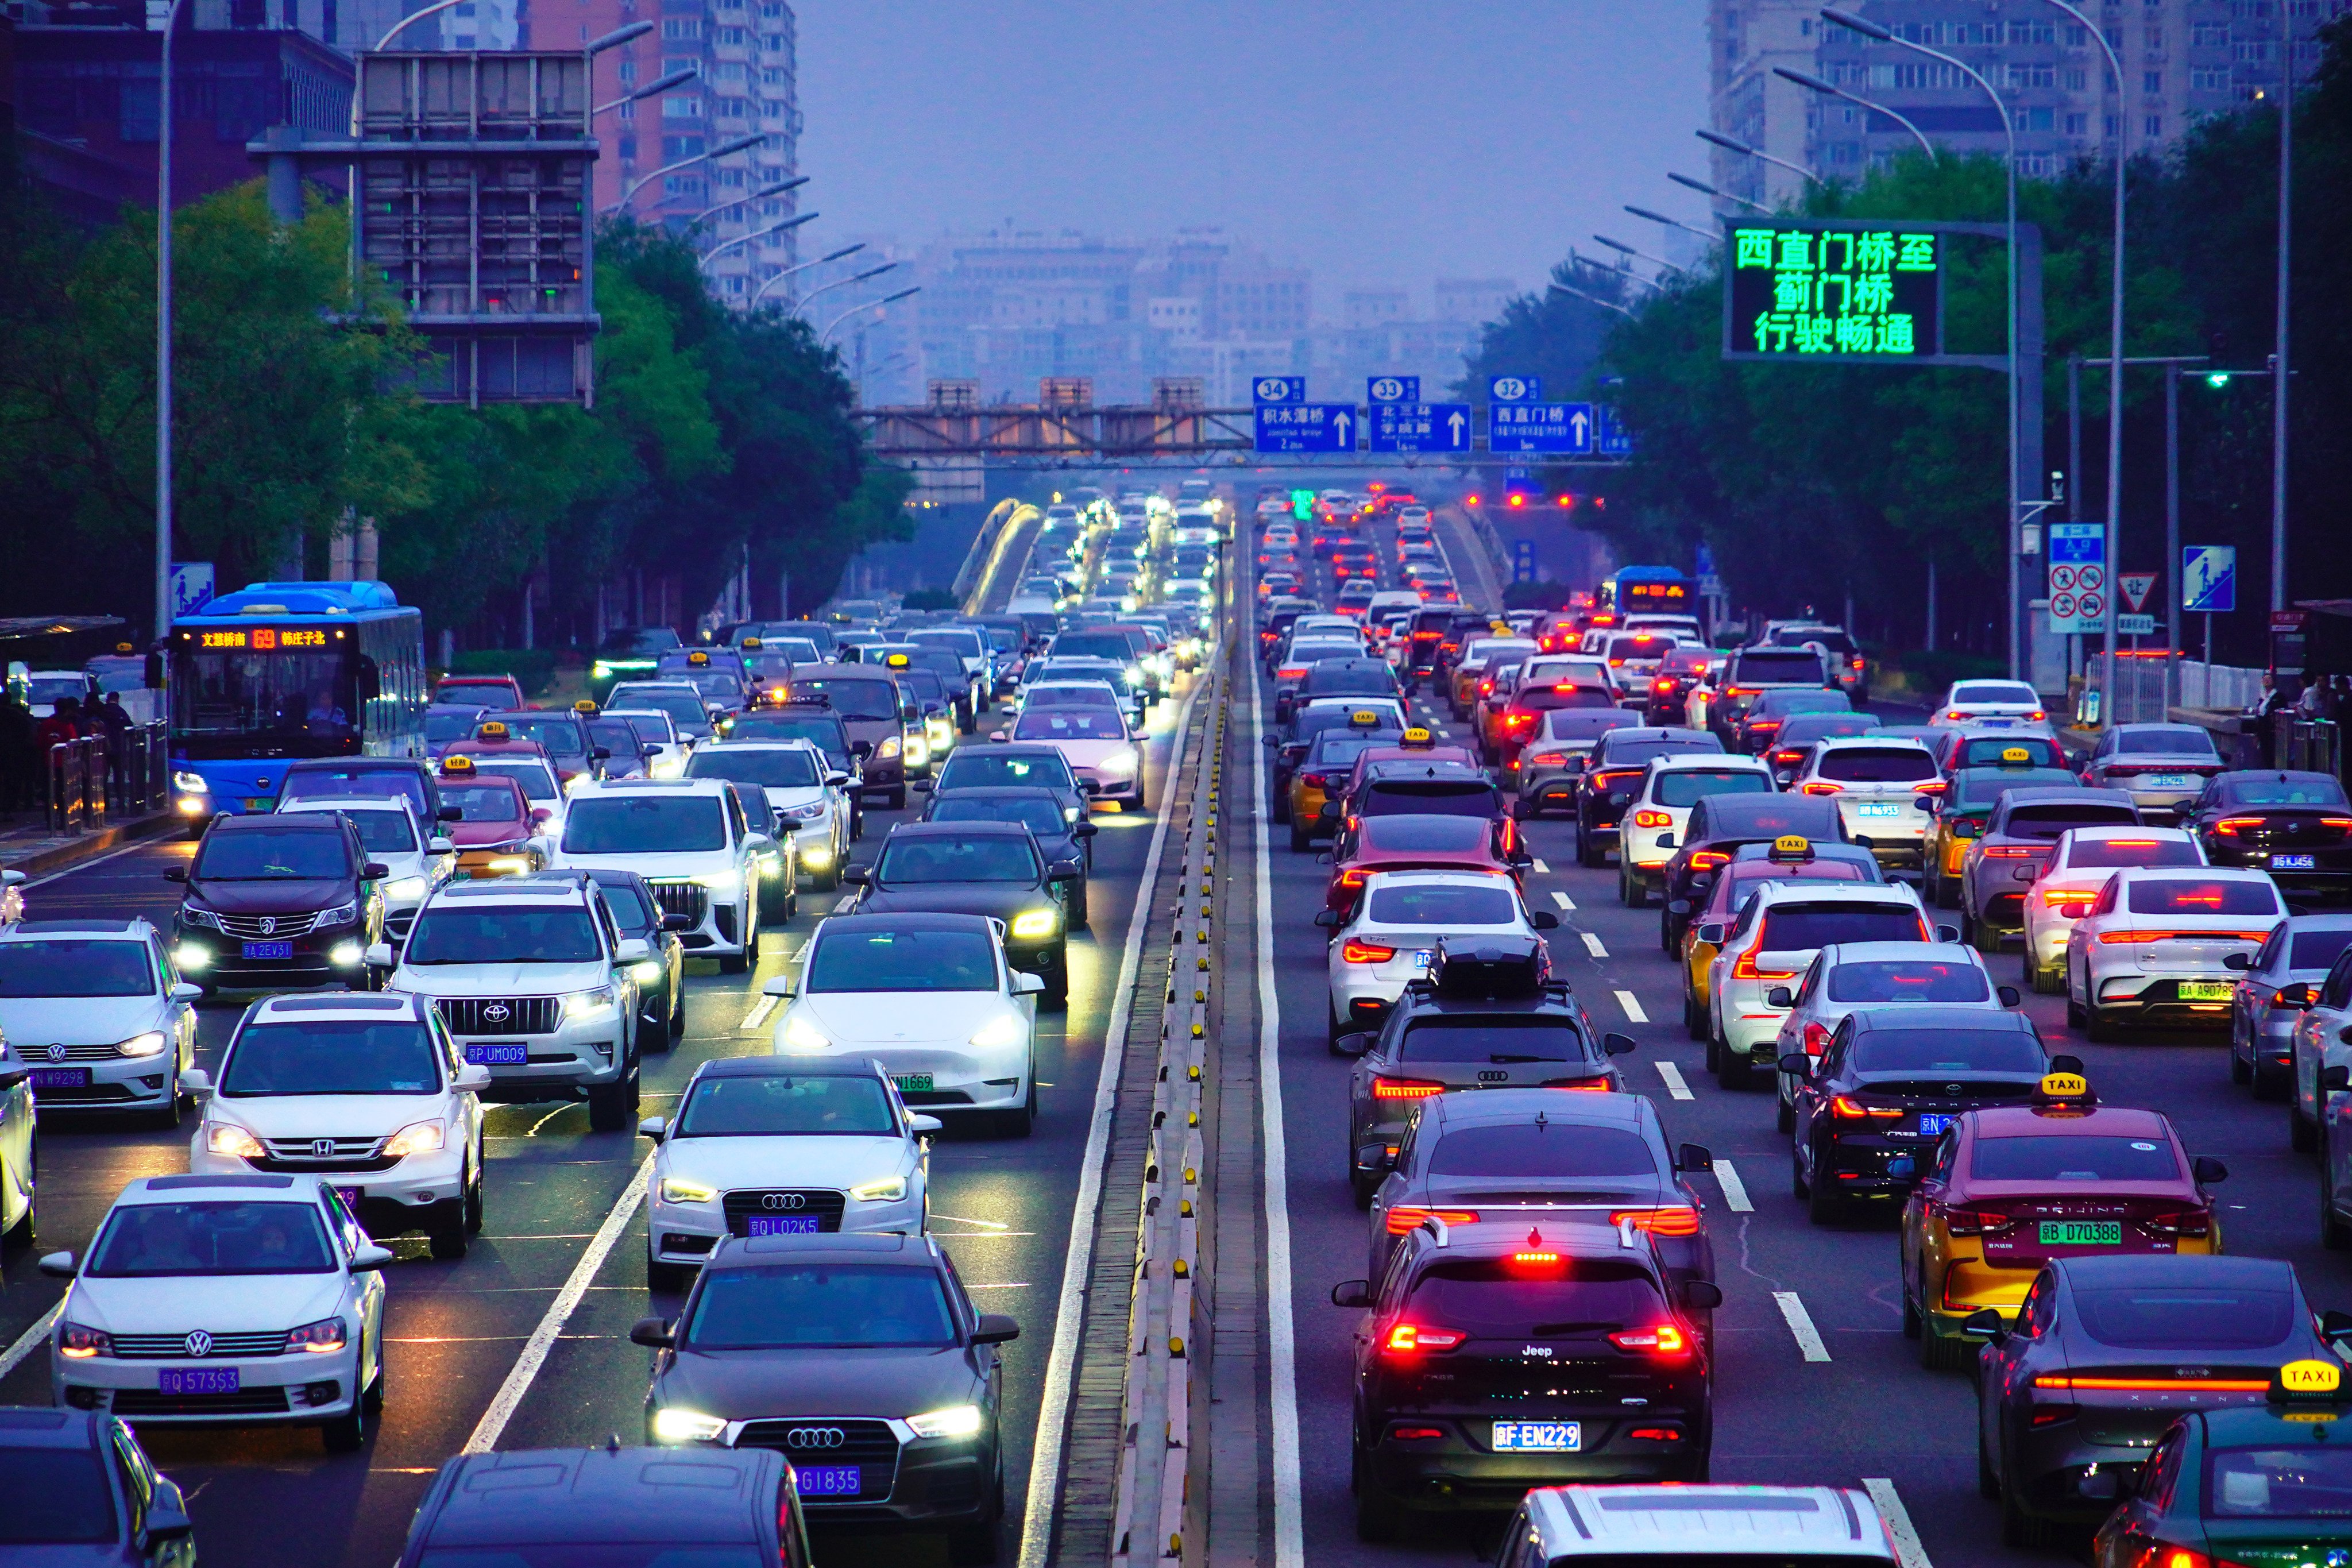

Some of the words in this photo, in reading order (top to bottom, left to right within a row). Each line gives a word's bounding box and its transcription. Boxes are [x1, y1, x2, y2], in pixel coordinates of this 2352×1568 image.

[1735, 229, 1936, 272] 西直门桥至
[1774, 271, 1894, 313] 蓟门桥
[1755, 311, 1914, 354] 行驶畅通
[1265, 383, 1282, 396] 34
[1379, 383, 1396, 396] 33
[1502, 381, 1518, 396] 32
[1263, 407, 1324, 424] 积水潭桥
[1497, 407, 1564, 423] 西直门桥
[2128, 579, 2142, 596] 让
[202, 632, 246, 647] 文慧桥南
[253, 629, 275, 648] 69
[281, 631, 326, 646] 韩庄子北
[2048, 1080, 2080, 1090] TAXI
[1522, 1345, 1552, 1358] Jeep
[2290, 1370, 2332, 1383] TAXI
